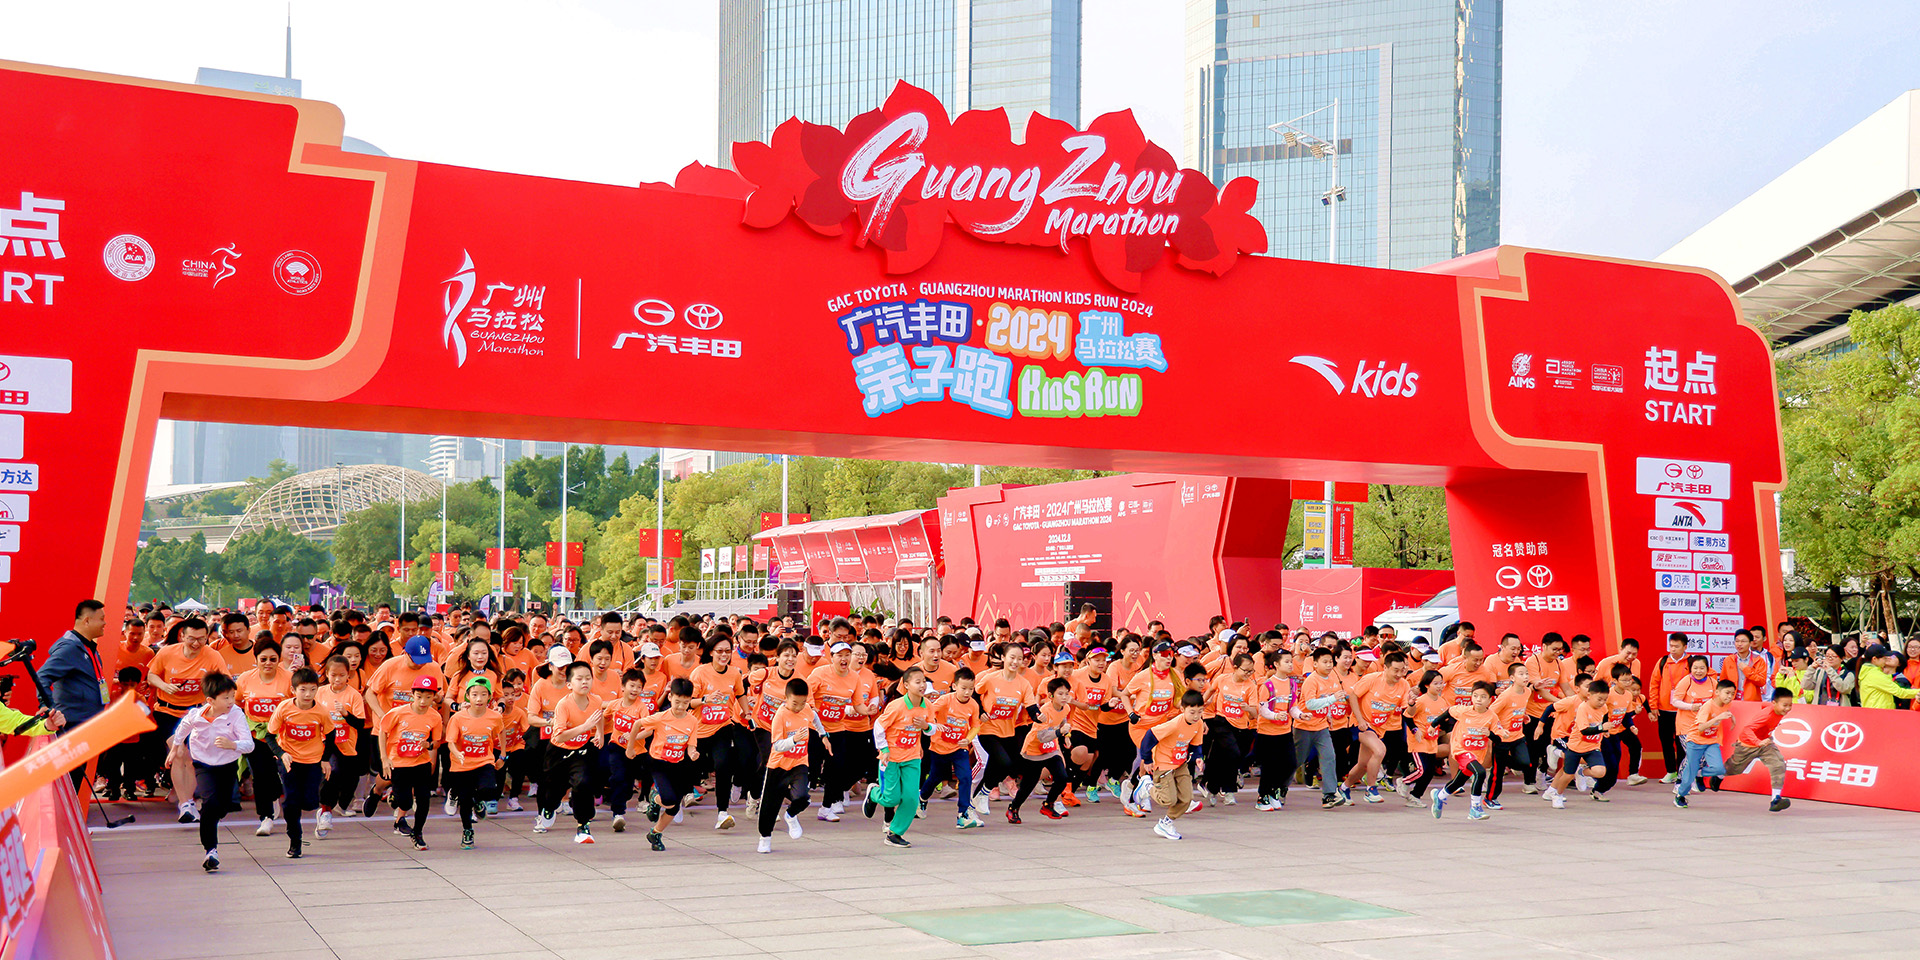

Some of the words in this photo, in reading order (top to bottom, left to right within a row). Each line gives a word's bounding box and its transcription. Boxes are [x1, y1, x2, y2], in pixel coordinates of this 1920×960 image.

[1044, 207, 1180, 253] Marathon
[182, 259, 216, 270] CHINA
[482, 282, 546, 310] 广州
[827, 295, 854, 313] GAC
[854, 283, 908, 301] TOYOTA
[919, 282, 995, 299] GUANGZHOU
[997, 288, 1063, 303] MARATHON
[1064, 291, 1092, 306] KIDS
[1093, 295, 1119, 309] RUN
[1121, 298, 1154, 318] 2024
[467, 308, 545, 332] 马拉松
[1083, 313, 1119, 337] 广州
[841, 301, 969, 350] 广汽丰田
[988, 305, 1068, 354] 2024
[470, 330, 545, 344] GUANGZHOU
[477, 341, 545, 356] Marathon
[612, 332, 742, 358] 广汽丰田
[1078, 337, 1162, 362] 马拉松赛
[1644, 346, 1717, 395] 起点
[855, 347, 1010, 413] 亲子跑
[1351, 360, 1419, 398] kids
[1508, 376, 1535, 389] AIMS
[1645, 399, 1716, 426] START
[1656, 481, 1712, 495] 广汽丰田
[1012, 504, 1041, 521] 广汽丰田
[1672, 514, 1693, 527] ANTA
[1492, 541, 1548, 558] 冠名赞助商
[1705, 537, 1727, 548] 易方达
[1711, 577, 1731, 589] 蒙牛
[1487, 595, 1569, 612] 广汽丰田
[1664, 618, 1678, 626] CPT
[1087, 692, 1102, 701] 019
[253, 704, 277, 713] 030
[706, 711, 726, 720] 077
[822, 709, 841, 719] 082
[994, 709, 1012, 717] 007
[1150, 704, 1169, 713] 019
[1225, 706, 1241, 715] 060
[616, 717, 632, 729] 071
[290, 728, 312, 737] 030
[945, 732, 962, 740] 037
[1464, 737, 1485, 747] 043
[665, 749, 683, 758] 039
[1742, 757, 1879, 787] 汽丰田
